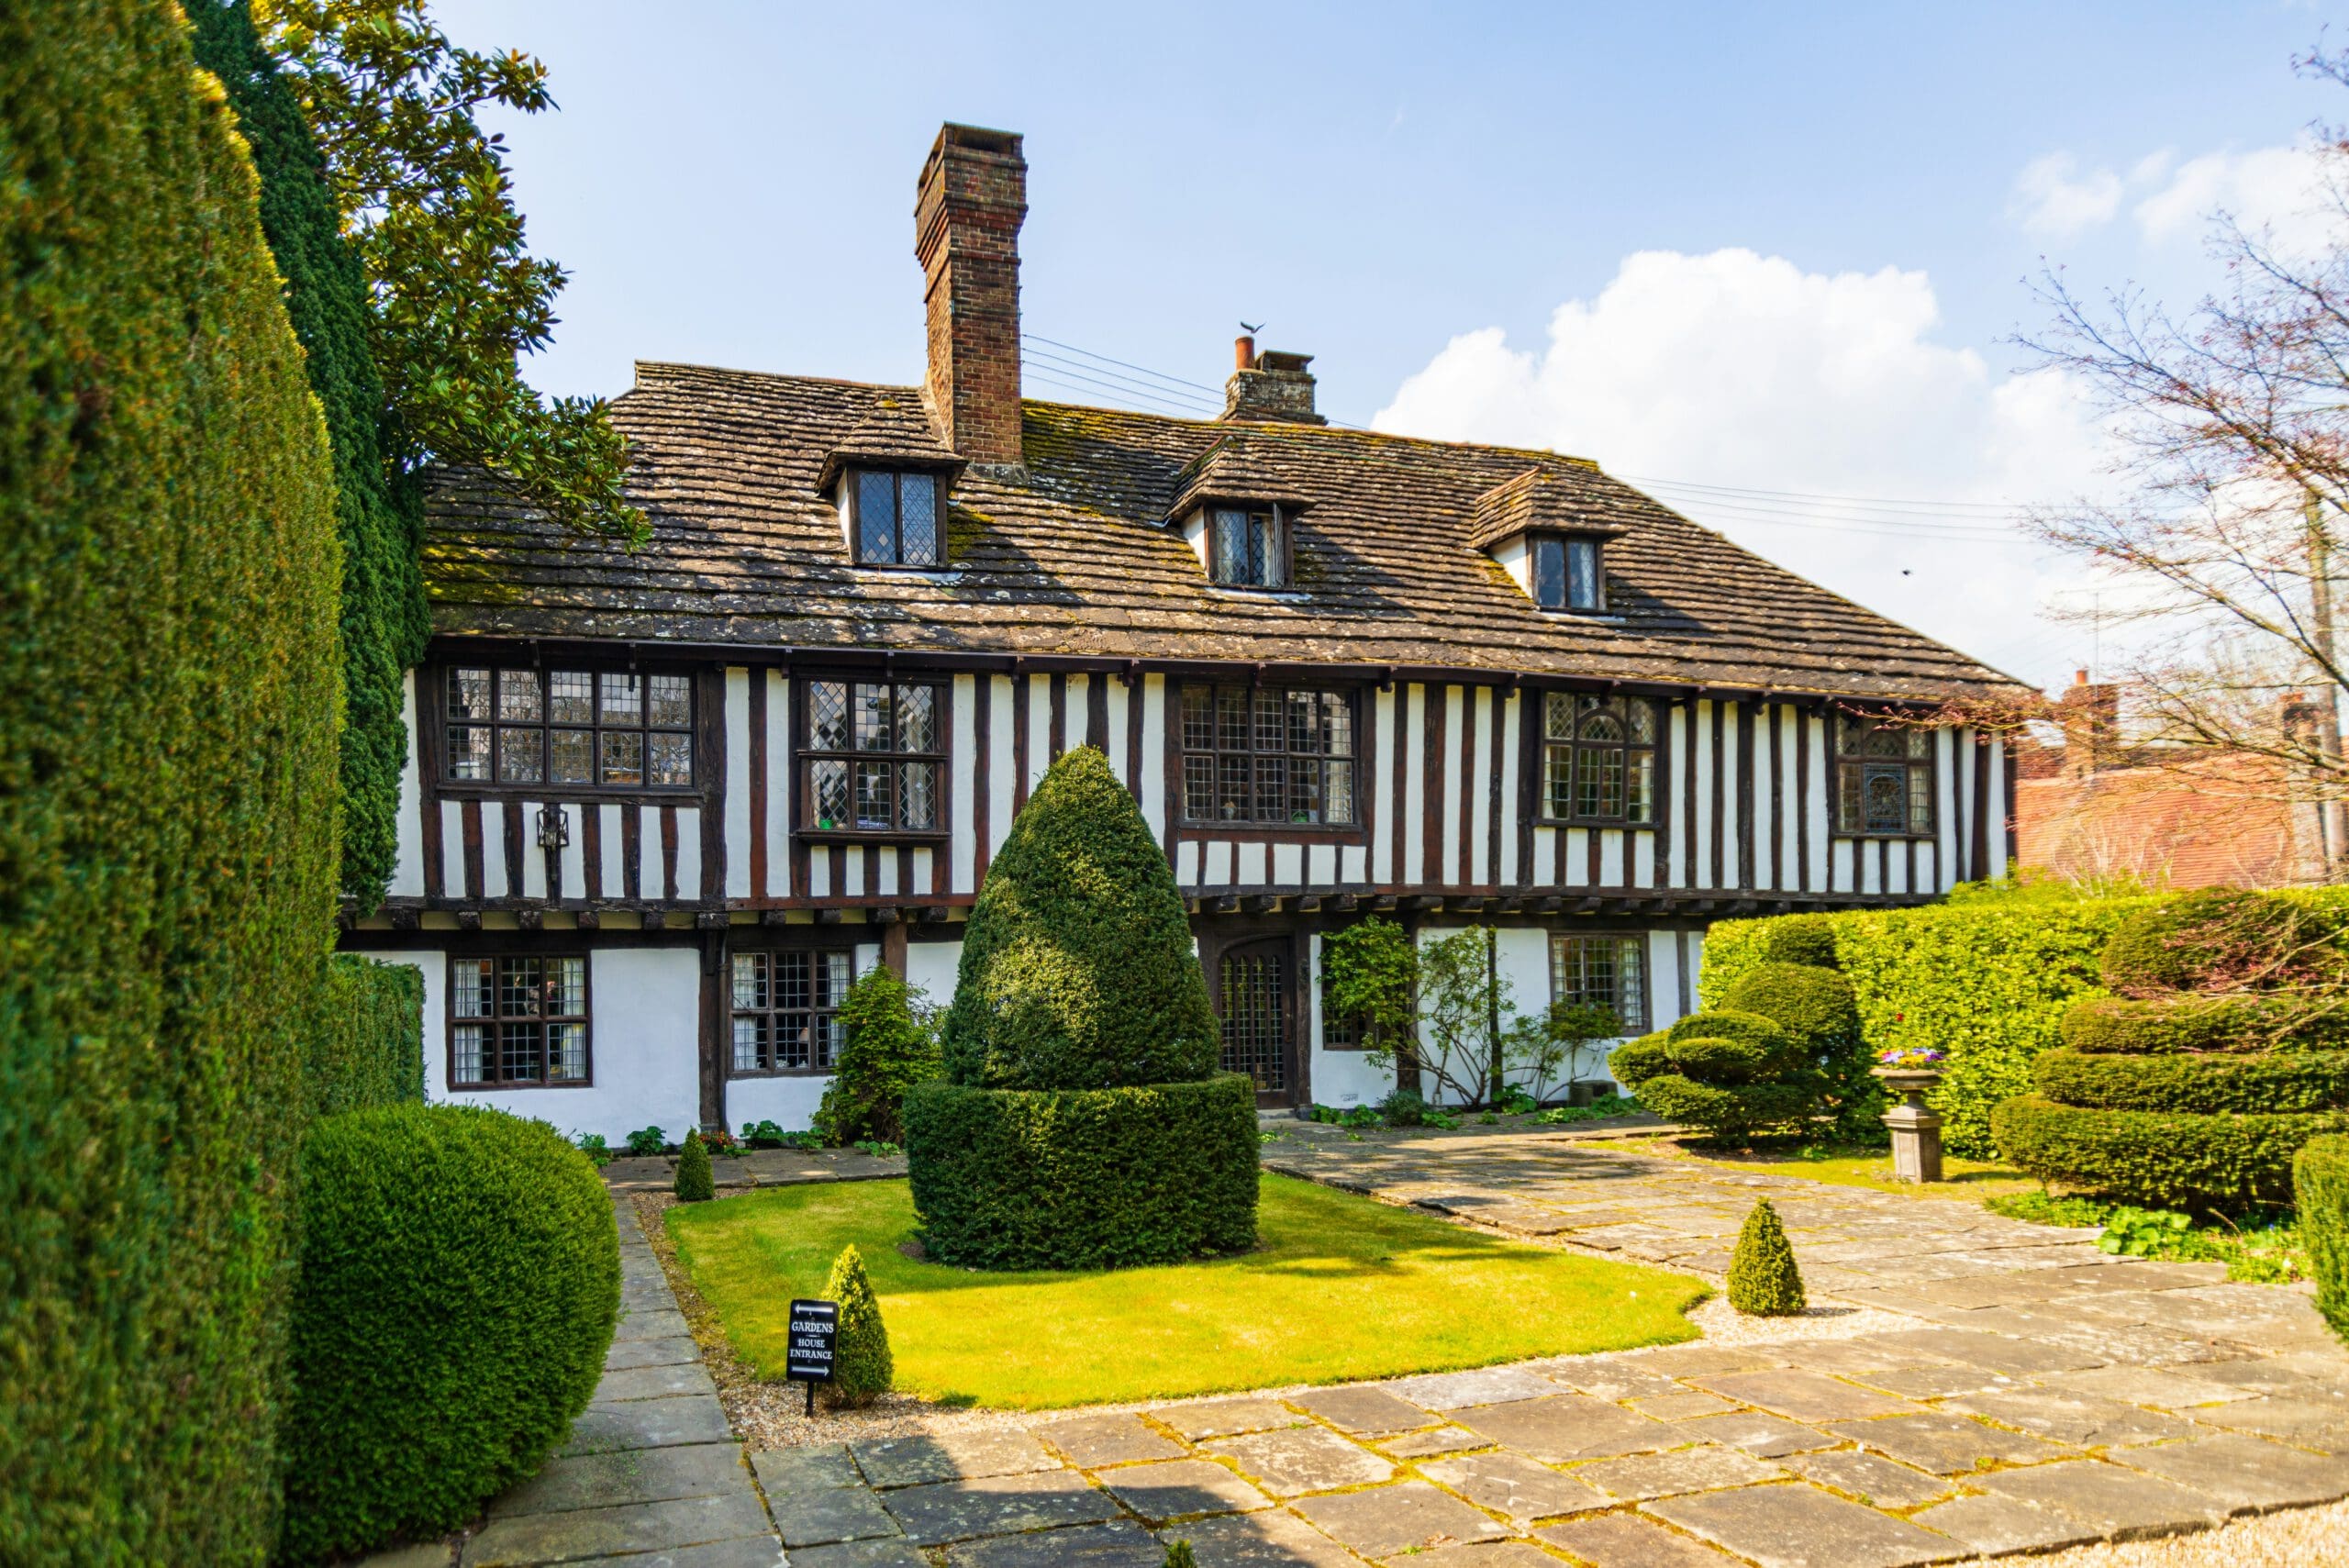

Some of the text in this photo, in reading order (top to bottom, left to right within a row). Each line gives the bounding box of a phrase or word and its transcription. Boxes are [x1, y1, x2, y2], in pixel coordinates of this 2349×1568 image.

[792, 1321, 834, 1333] GARDENS
[797, 1339, 825, 1348] HOUSE
[790, 1349, 832, 1360] ENTRANCE
